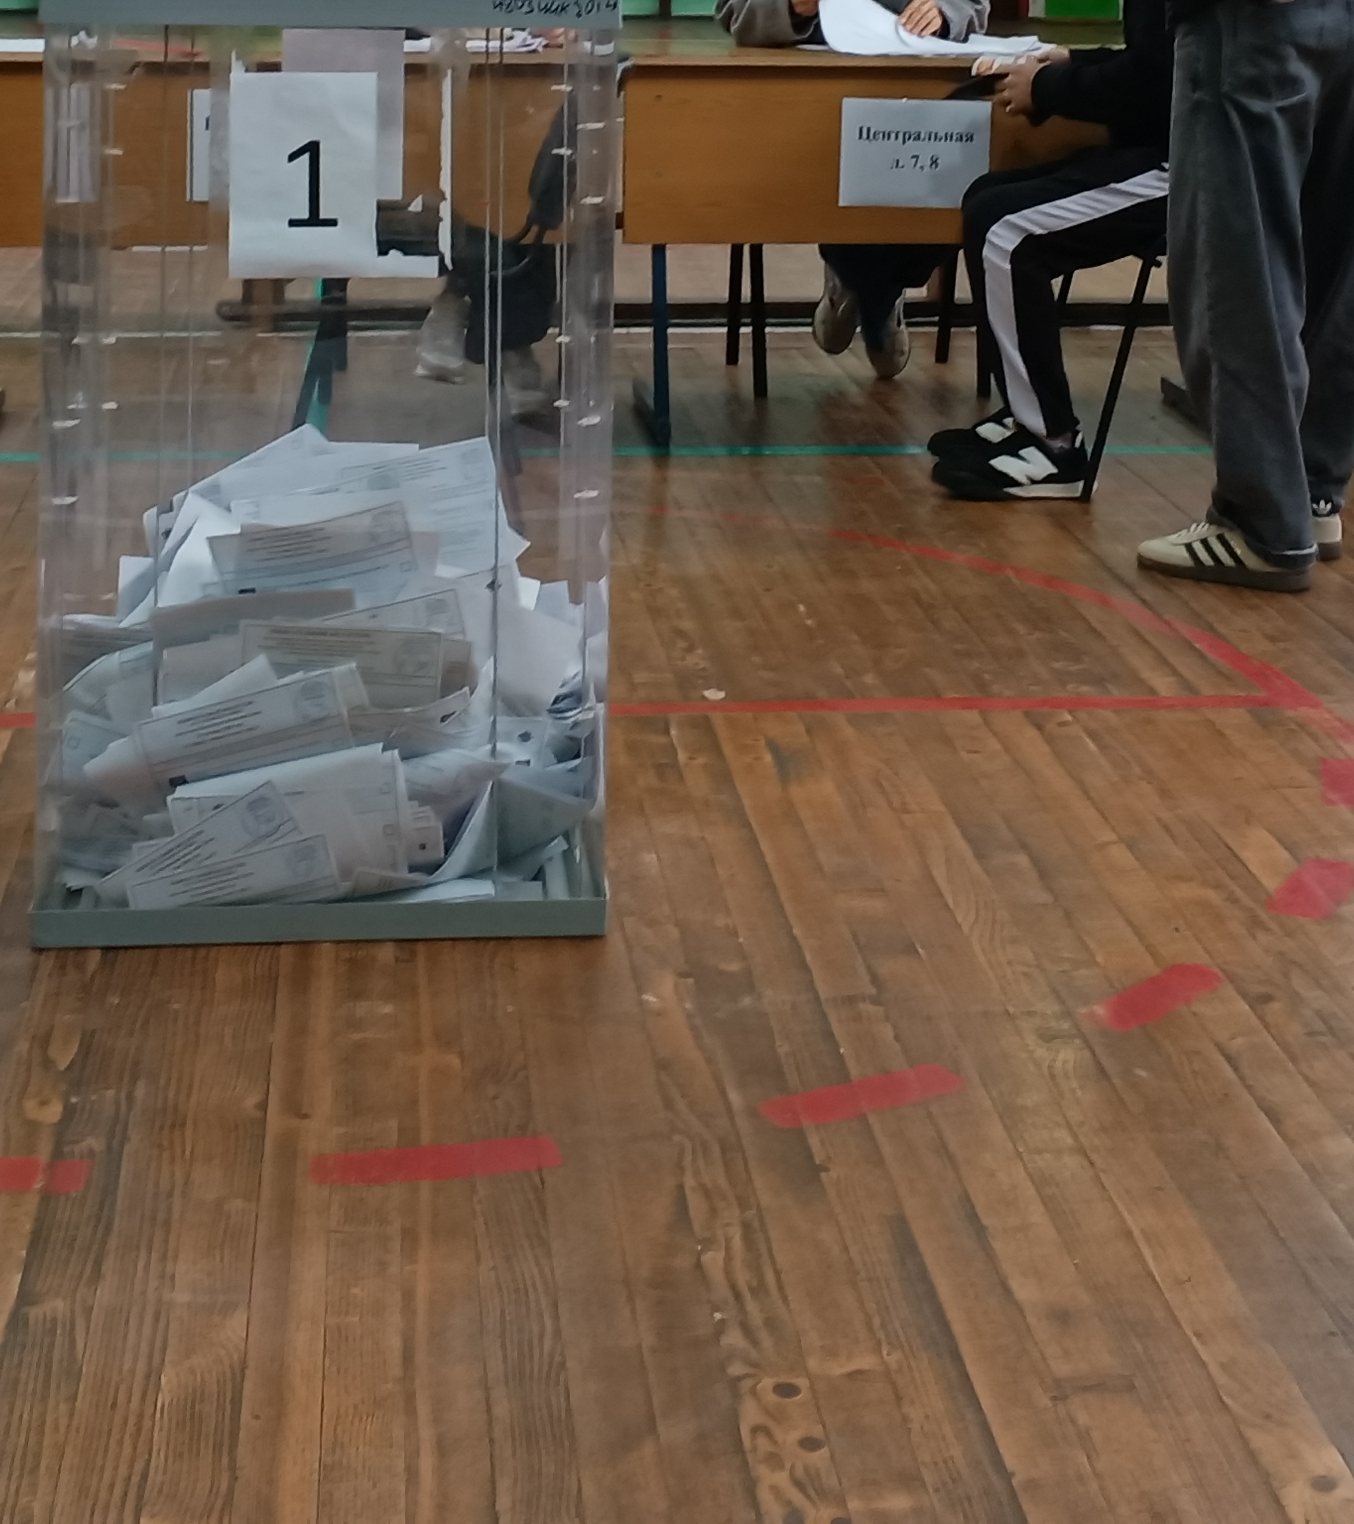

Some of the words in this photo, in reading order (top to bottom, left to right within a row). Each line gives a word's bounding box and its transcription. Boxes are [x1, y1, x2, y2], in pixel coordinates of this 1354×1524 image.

[857, 124, 975, 146] Центральная
[910, 154, 925, 173] 7,
[929, 154, 940, 171] 8
[287, 140, 338, 228] 1
